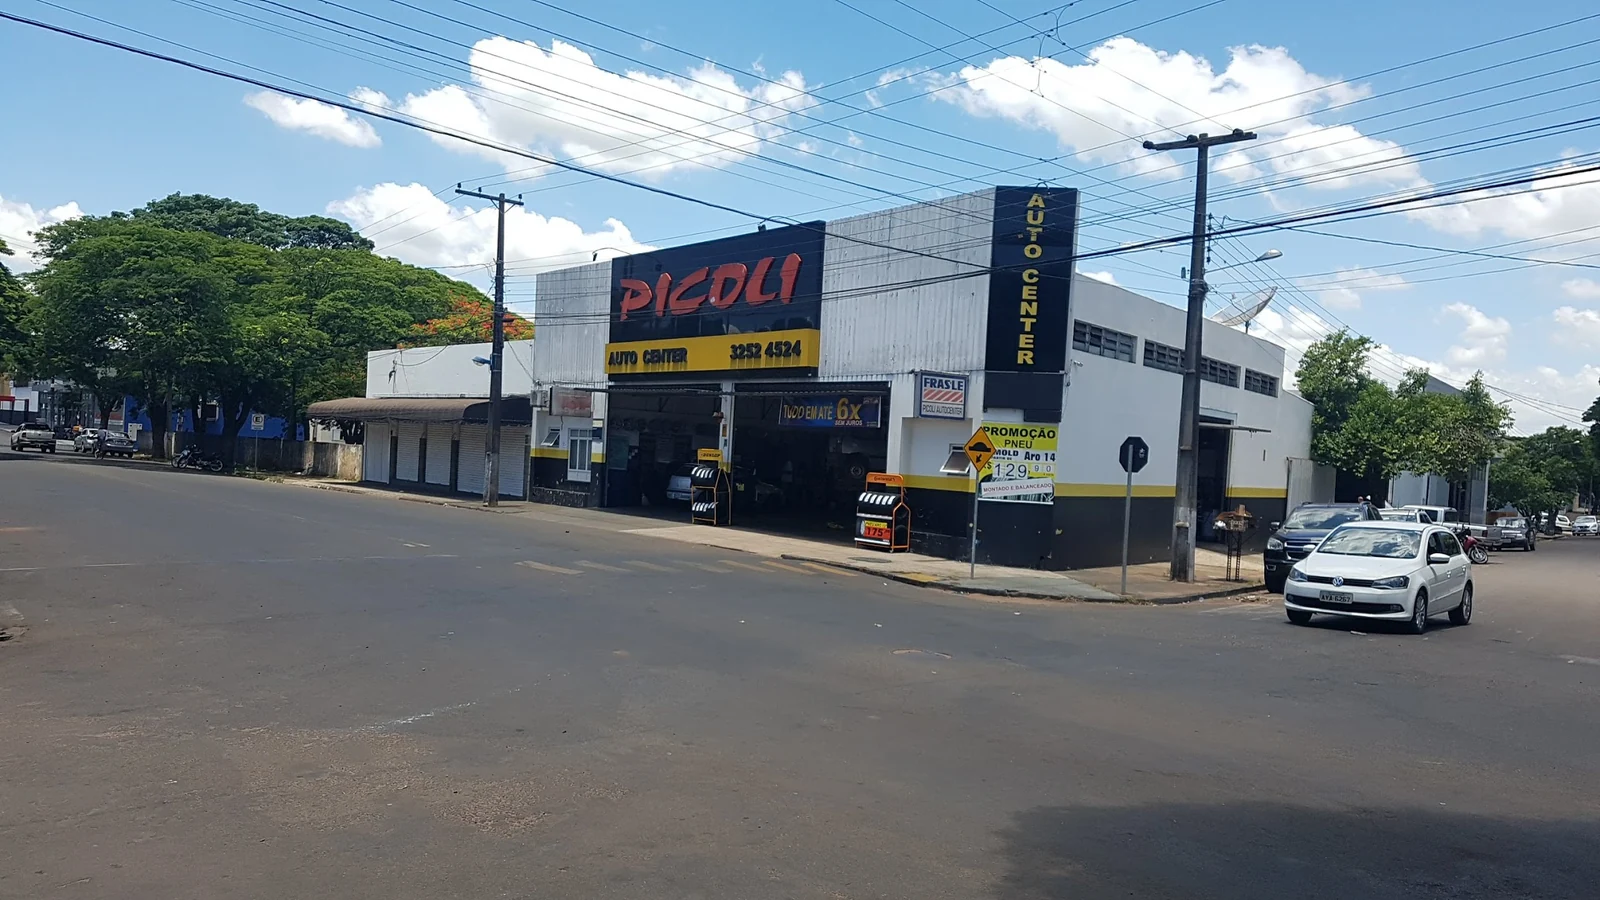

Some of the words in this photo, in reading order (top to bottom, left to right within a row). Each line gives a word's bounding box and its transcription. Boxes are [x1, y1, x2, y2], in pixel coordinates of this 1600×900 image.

[1024, 193, 1046, 258] AUTO
[619, 253, 802, 321] PICOLI
[1017, 268, 1040, 365] CENTER
[608, 351, 638, 366] AUTO
[643, 347, 688, 365] CENTER
[730, 342, 762, 360] 3252
[764, 340, 802, 358] 4524
[783, 404, 804, 419] TUDO
[805, 405, 817, 419] EM
[817, 402, 833, 420] ATÉ
[983, 426, 1056, 440] PROMOÇÃO
[1004, 439, 1033, 449] PNEU
[1024, 451, 1041, 461] Aro
[1044, 452, 1056, 462] 14
[1015, 482, 1052, 490] BALANCEADO
